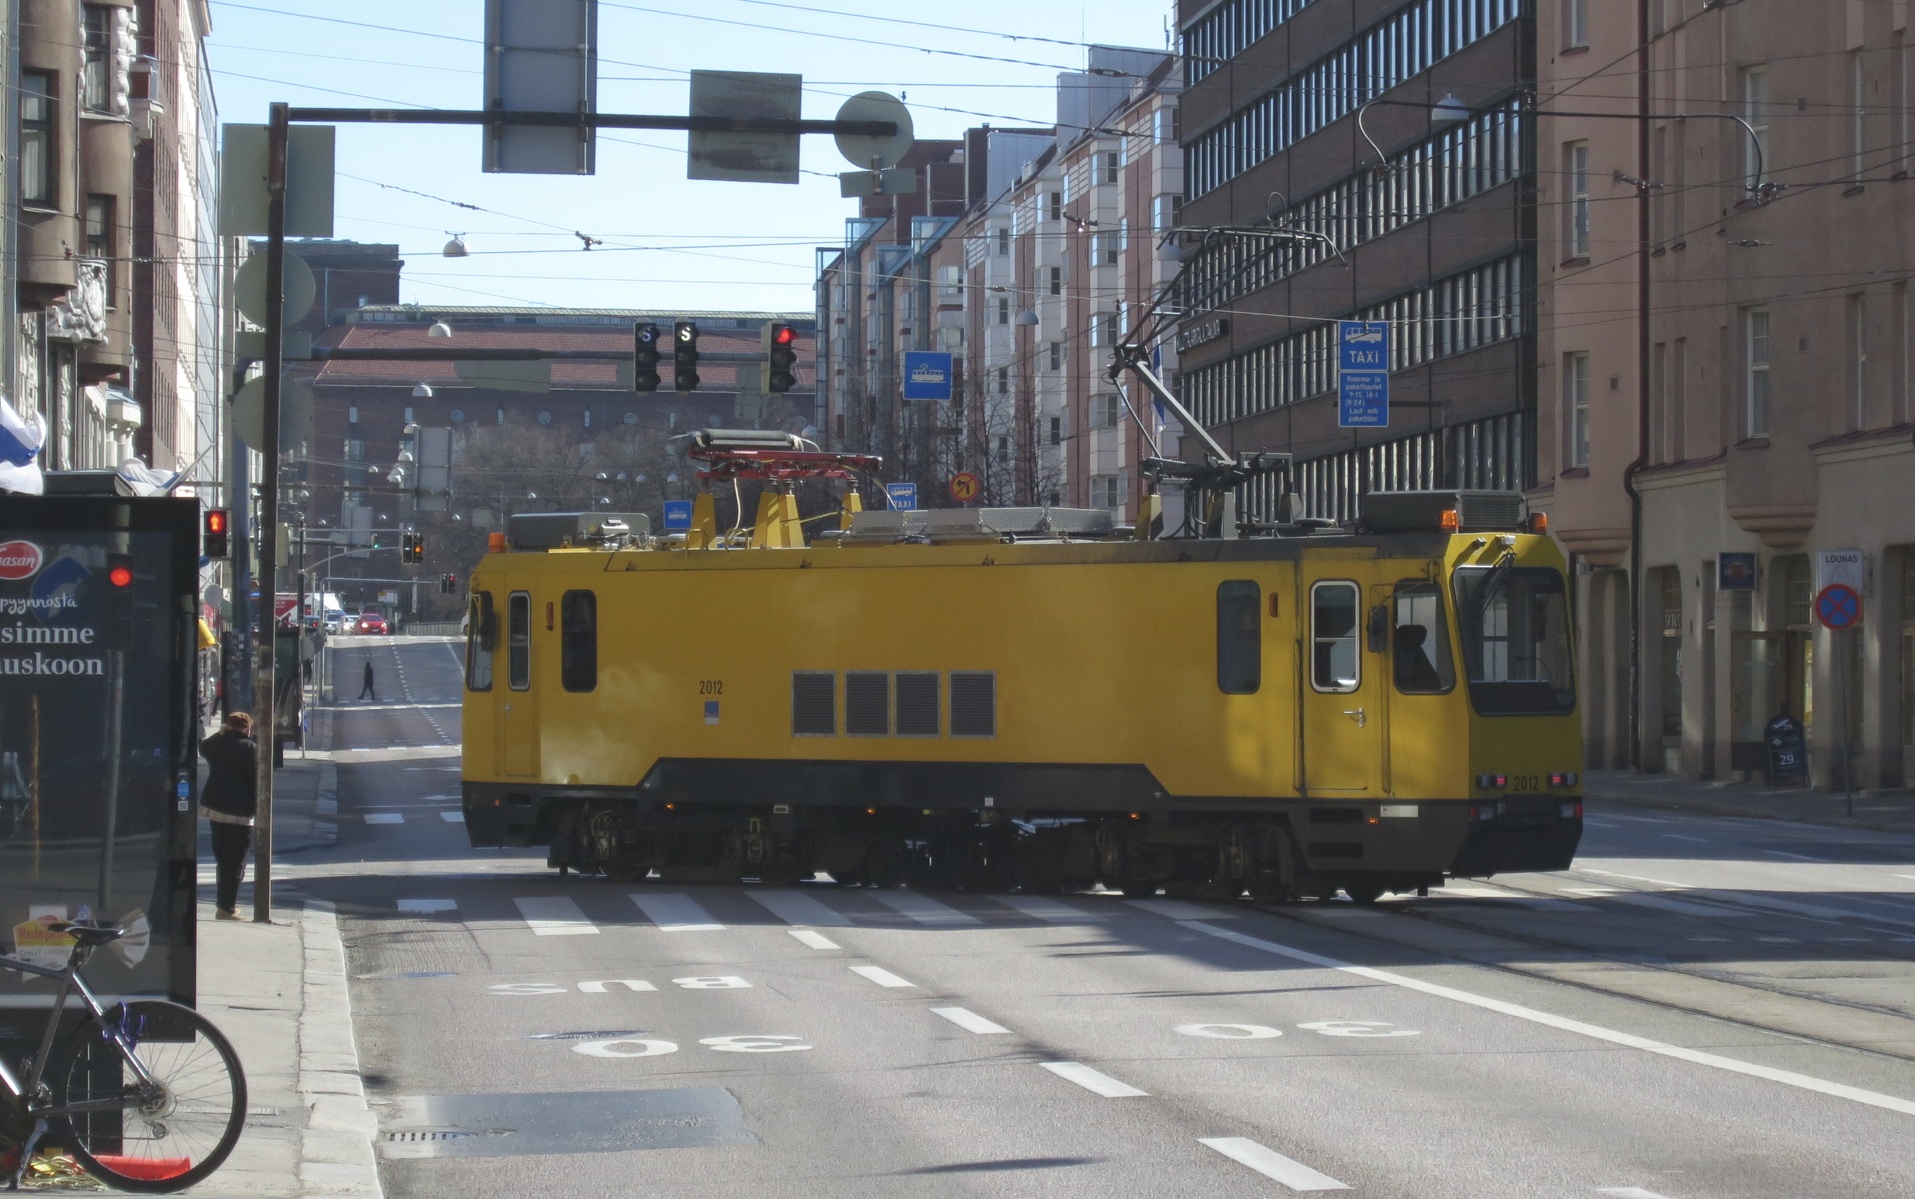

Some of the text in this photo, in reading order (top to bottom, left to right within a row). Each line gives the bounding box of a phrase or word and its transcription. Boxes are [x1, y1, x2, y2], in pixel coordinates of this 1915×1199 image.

[1349, 351, 1379, 363] TAXI
[0, 557, 35, 569] asan
[1825, 554, 1858, 563] LOUNAS
[0, 592, 78, 614] pyynnöstä
[1, 621, 94, 644] simme
[0, 651, 104, 675] uskoon
[699, 680, 723, 695] 2012
[1780, 754, 1795, 766] 29
[1514, 775, 1539, 791] 2012
[486, 976, 753, 995] BUS
[1172, 1021, 1421, 1039] 30
[571, 1035, 814, 1058] 30
